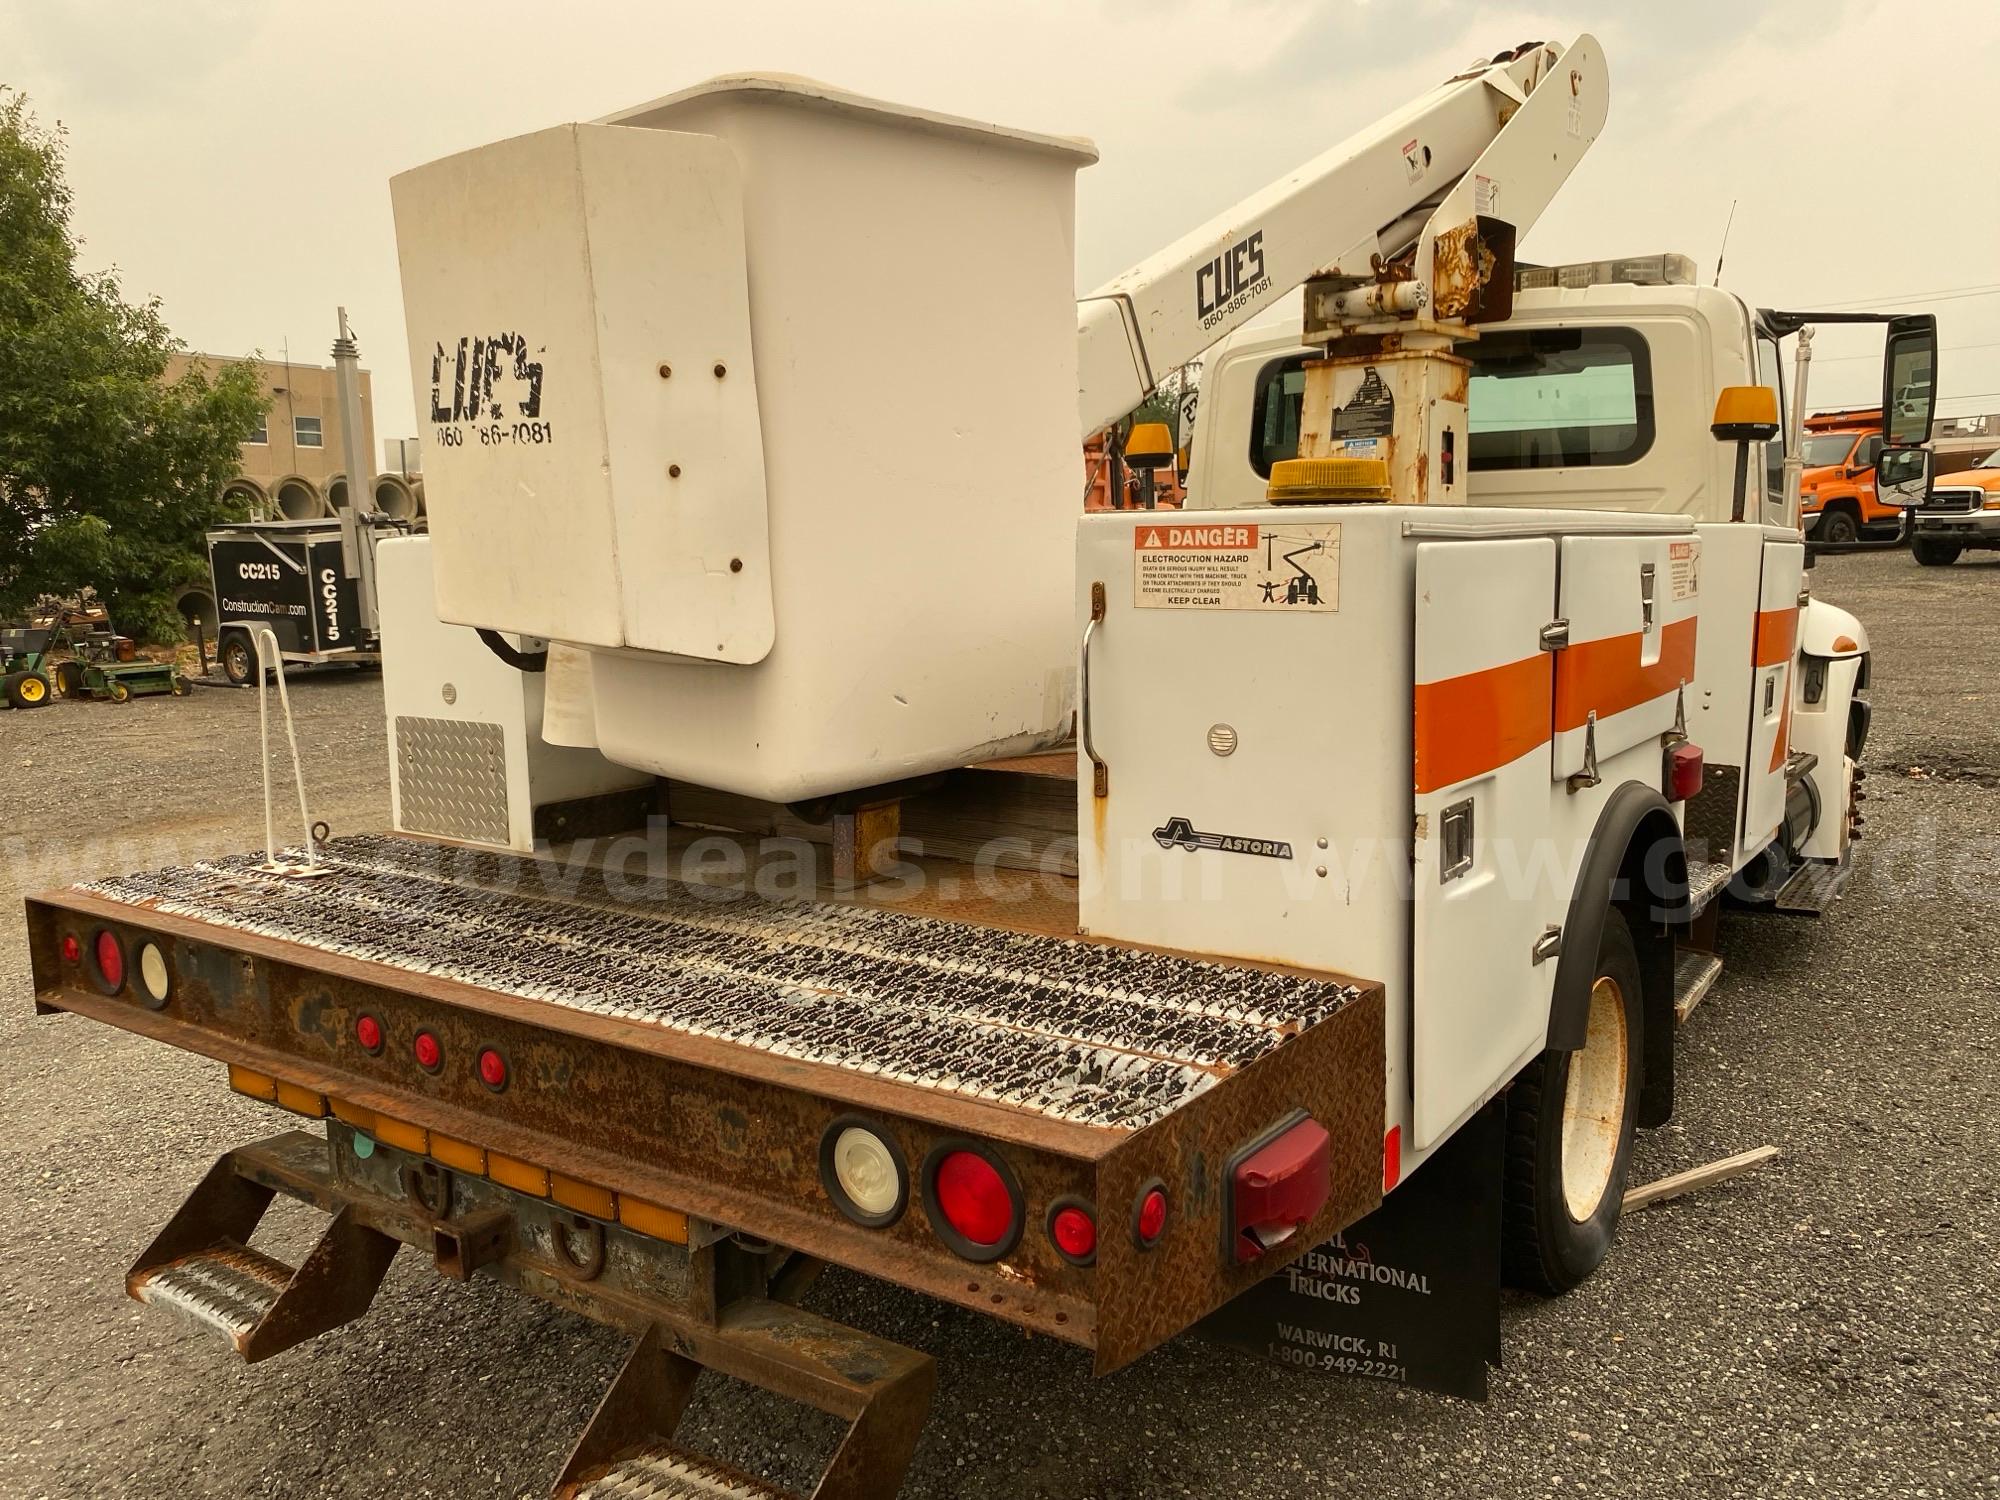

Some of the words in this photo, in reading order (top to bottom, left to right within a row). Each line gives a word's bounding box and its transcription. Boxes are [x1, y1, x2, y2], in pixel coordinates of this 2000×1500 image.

[1196, 229, 1264, 320] CUES
[1203, 275, 1273, 330] 860-886-7081
[1169, 527, 1249, 547] DANGER
[239, 563, 281, 580] CC215
[1142, 555, 1212, 563] ELECTROCUTION
[1213, 555, 1249, 563] HAZARD
[222, 597, 307, 616] ConstructionCam.com
[321, 568, 340, 641] CC215
[1168, 596, 1190, 605] KEEP
[1191, 597, 1221, 605] CLEAR
[1221, 837, 1291, 857] ASTORIA
[1285, 1267, 1361, 1305] TRUCKS
[1290, 1251, 1432, 1295] TERNATIONAL
[1277, 1322, 1372, 1357] WARWICK,
[1378, 1341, 1398, 1359] RI
[1267, 1342, 1407, 1382] 1-800-949-2221
